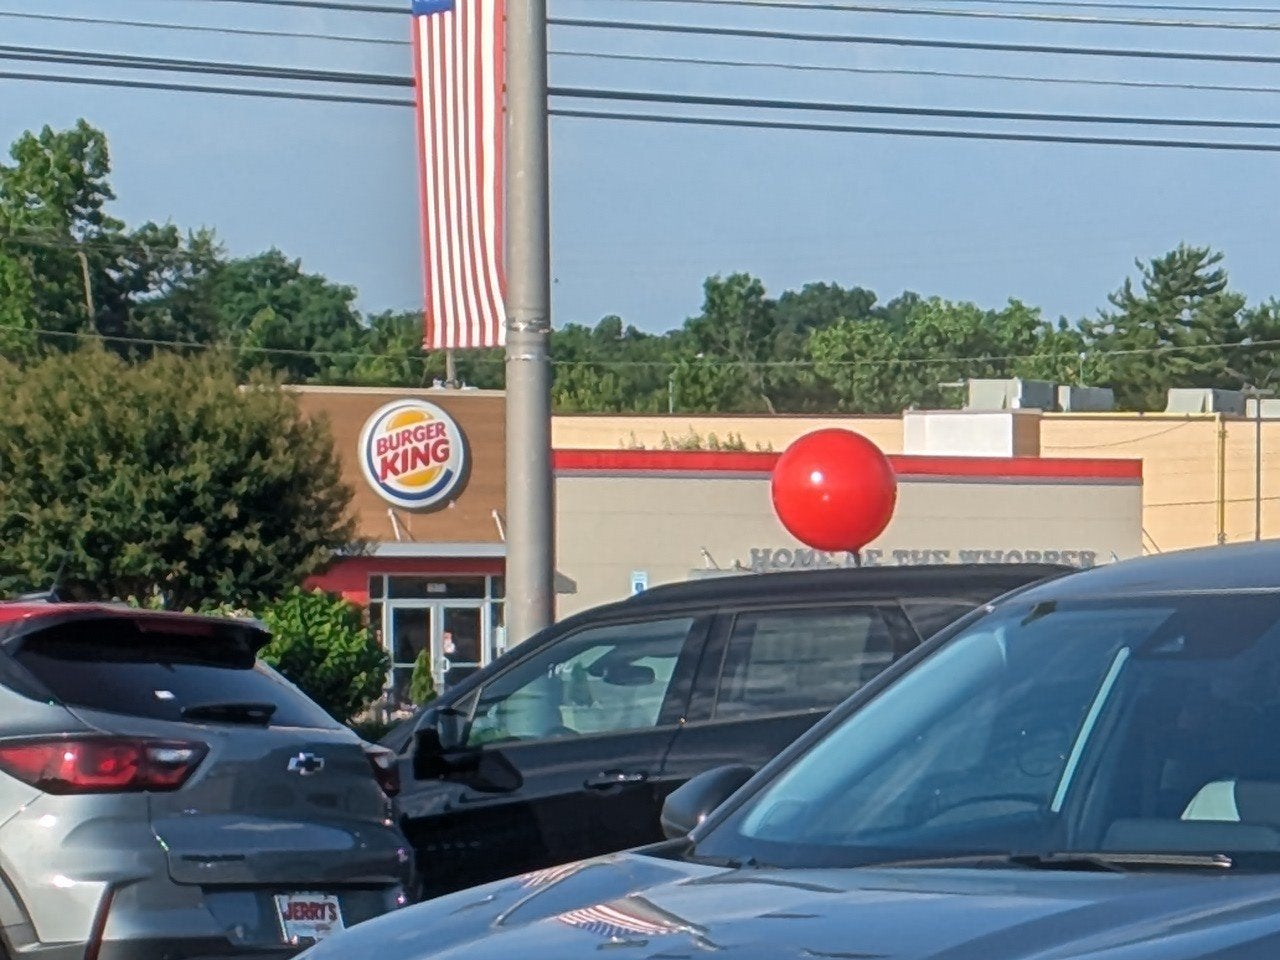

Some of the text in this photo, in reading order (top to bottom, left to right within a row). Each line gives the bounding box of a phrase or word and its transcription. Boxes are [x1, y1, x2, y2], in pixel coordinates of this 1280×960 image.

[376, 421, 447, 457] BURGER
[380, 438, 450, 481] KING
[959, 549, 1096, 568] WHOPPER
